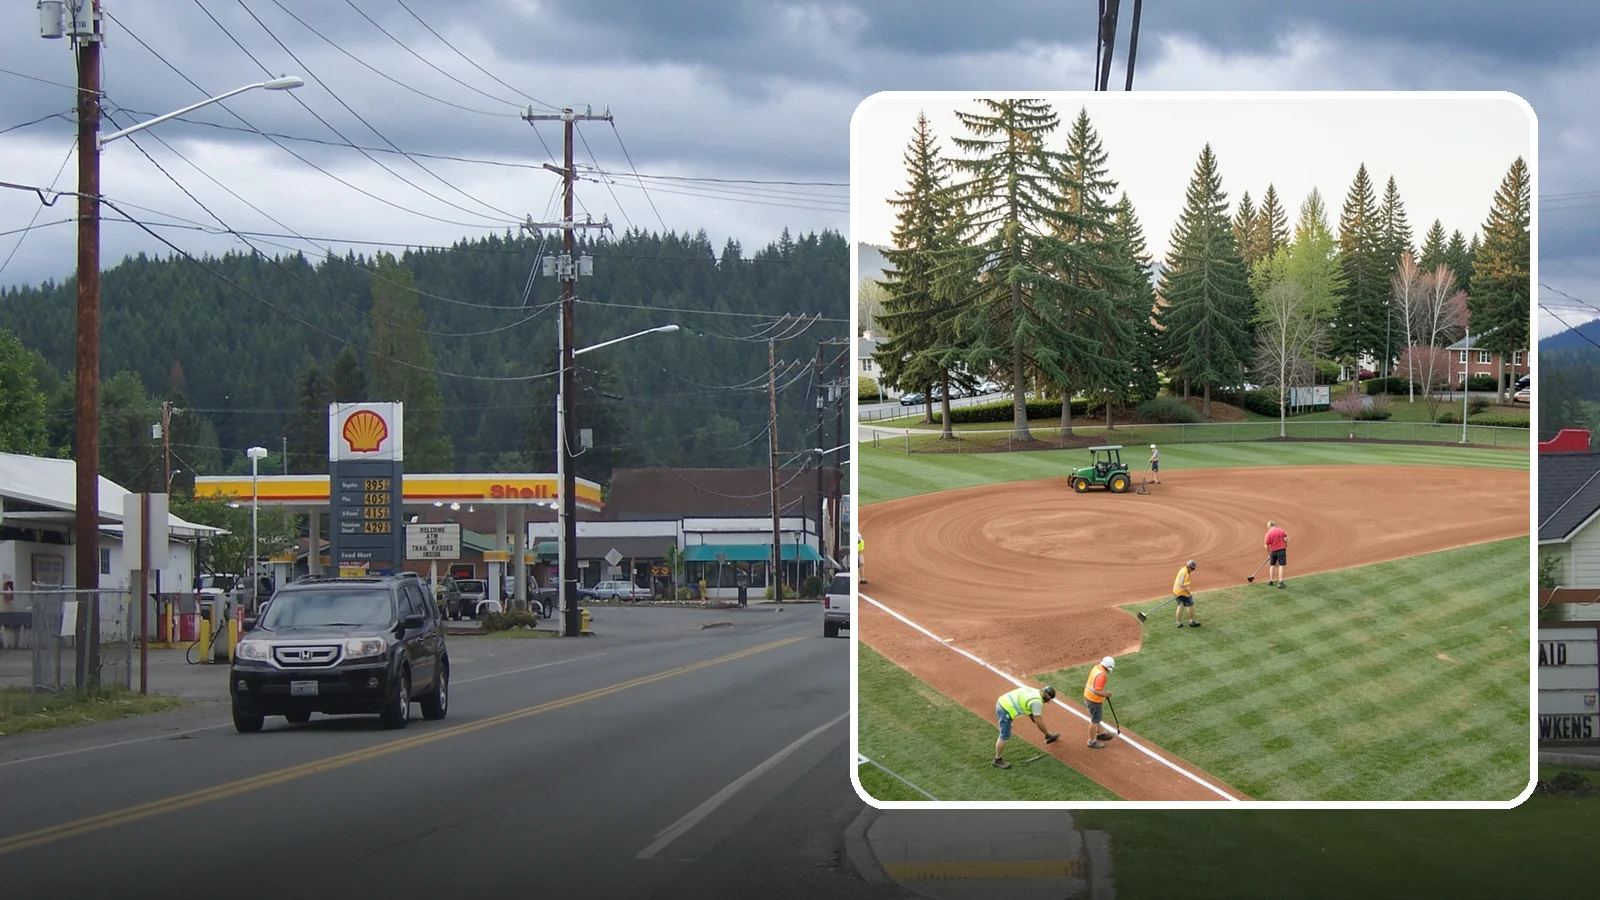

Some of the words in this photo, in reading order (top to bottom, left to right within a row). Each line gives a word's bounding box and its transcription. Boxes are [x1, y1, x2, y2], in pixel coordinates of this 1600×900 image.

[365, 480, 384, 490] 395
[489, 484, 547, 499] Shell
[365, 494, 384, 504] 405
[365, 508, 384, 518] 415
[365, 522, 384, 532] 429
[1539, 643, 1567, 665] AID
